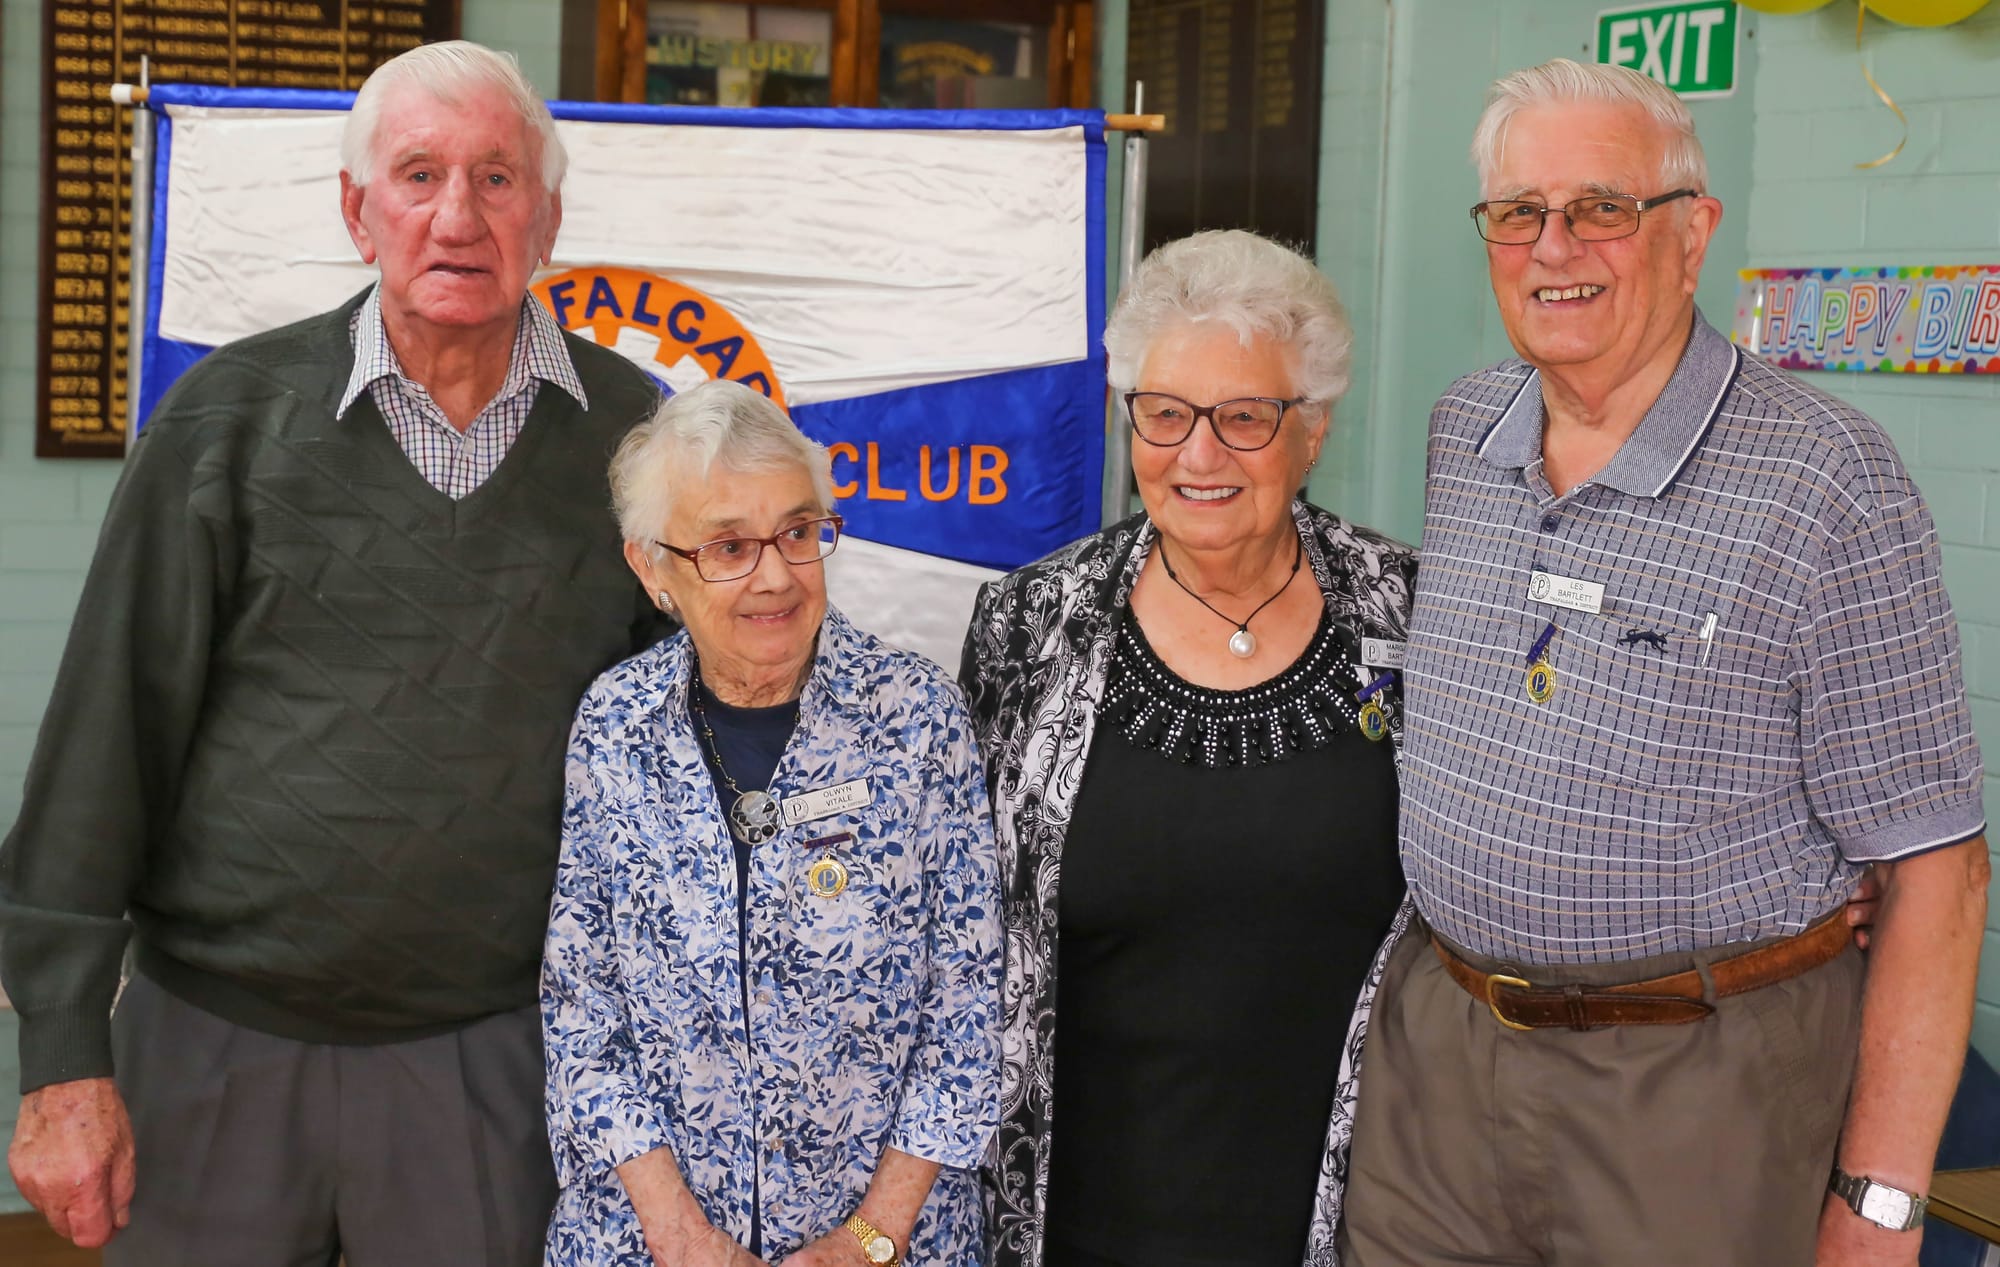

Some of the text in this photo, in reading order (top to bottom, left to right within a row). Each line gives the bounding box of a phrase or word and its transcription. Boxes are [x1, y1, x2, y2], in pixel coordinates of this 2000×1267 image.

[1609, 8, 1725, 86] EXIT
[1761, 275, 2000, 359] HAPPY BIR
[828, 441, 1010, 504] CLUB
[1570, 582, 1584, 591] LES
[1557, 589, 1592, 603] BARTLETT
[823, 785, 852, 798] OLWYN
[825, 794, 853, 807] VITALE
